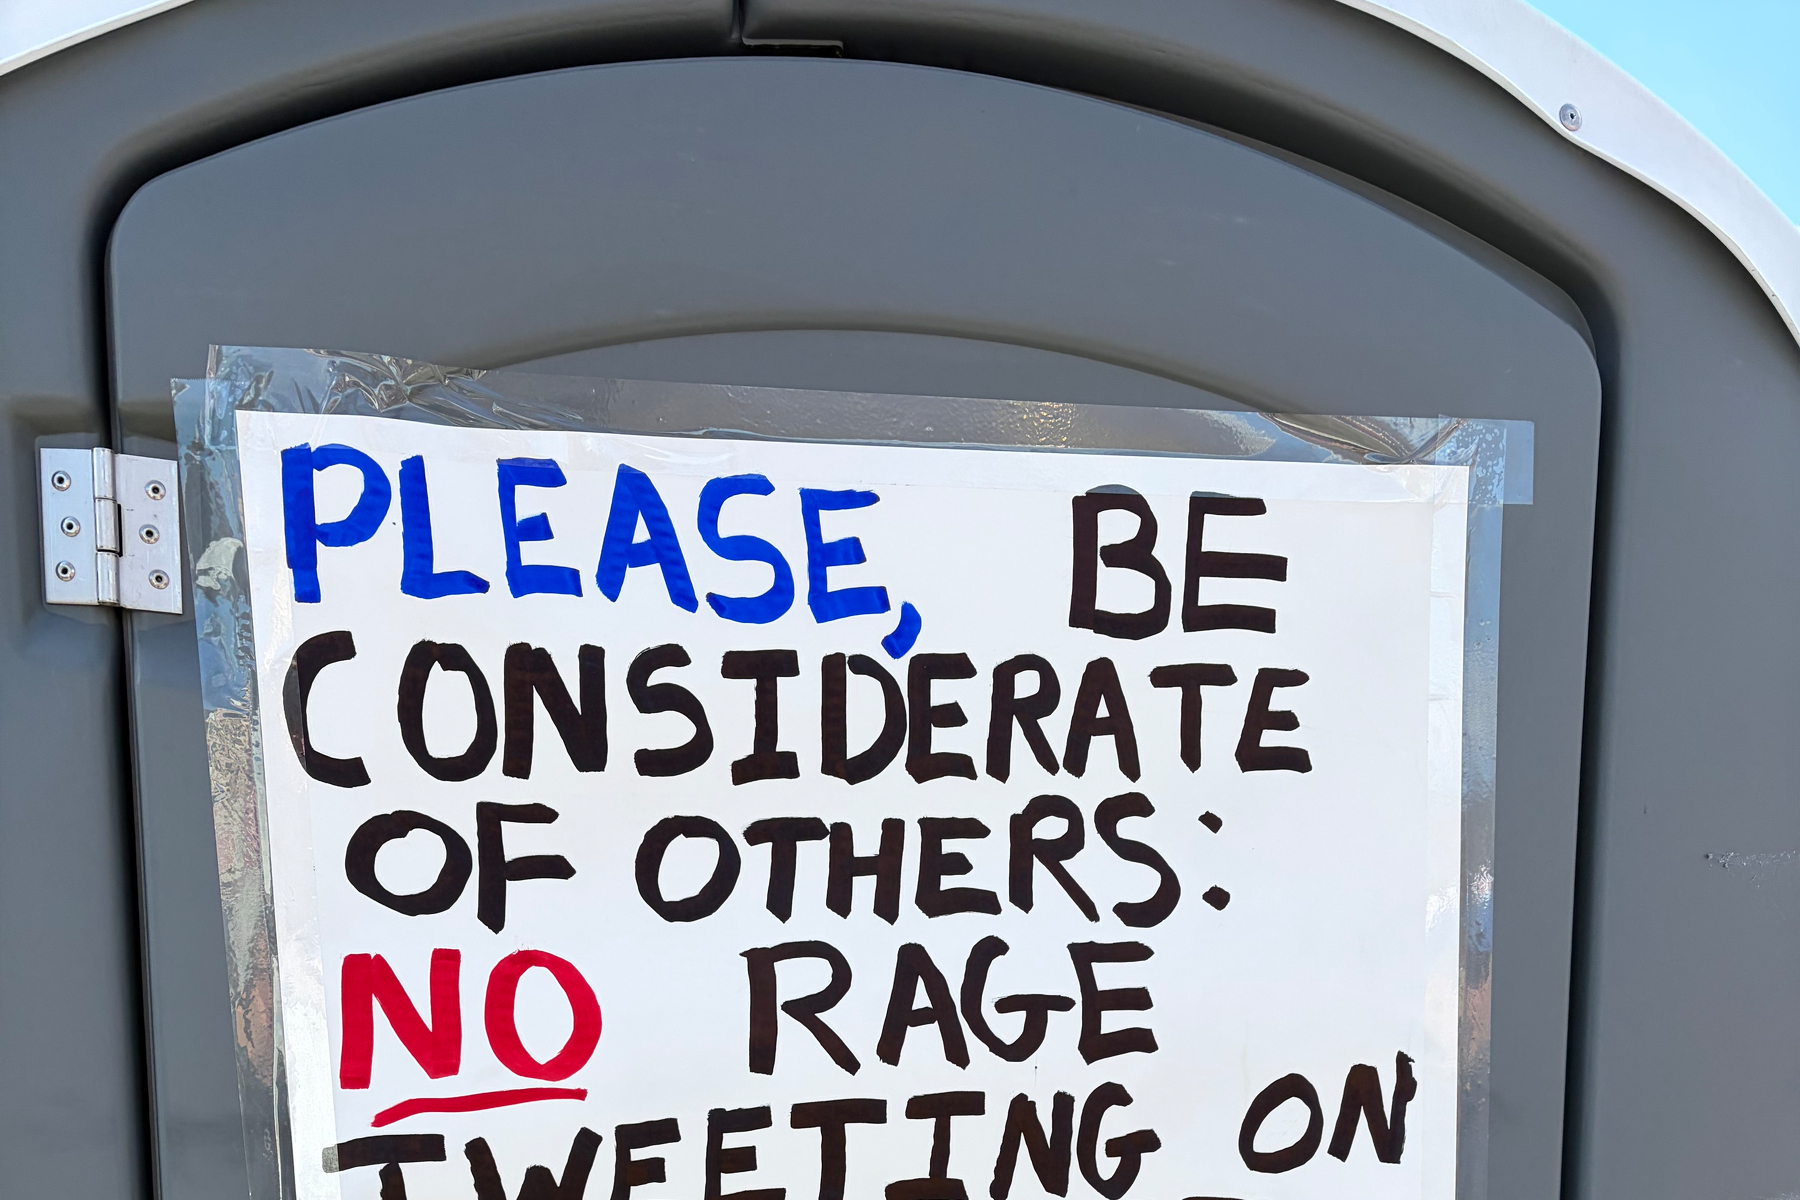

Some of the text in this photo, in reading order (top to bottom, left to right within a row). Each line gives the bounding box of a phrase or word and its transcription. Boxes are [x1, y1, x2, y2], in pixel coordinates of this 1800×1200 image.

[281, 443, 1287, 659] PLEASE, BE
[283, 631, 1312, 788] CONSIDERATE
[345, 792, 1230, 936] OF OTHERS:
[340, 935, 1158, 1089] NO RAGE
[1239, 1051, 1417, 1173] ON
